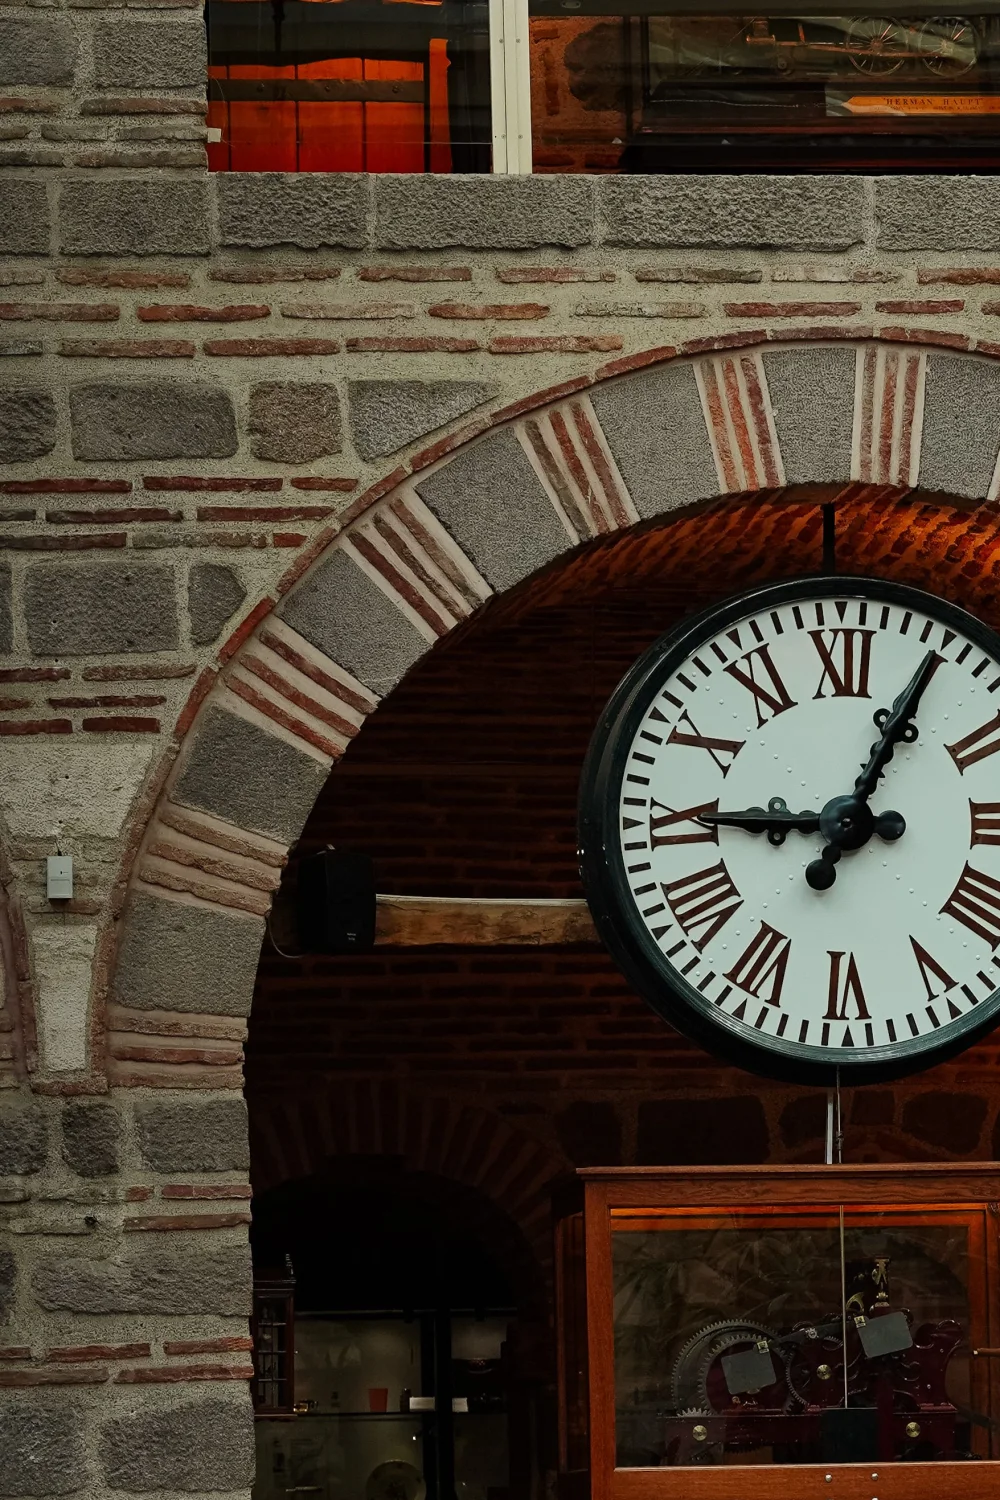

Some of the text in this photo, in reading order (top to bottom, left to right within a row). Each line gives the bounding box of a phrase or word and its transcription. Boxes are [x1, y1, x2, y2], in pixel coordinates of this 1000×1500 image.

[723, 643, 798, 729] XI
[807, 628, 877, 700] XII
[667, 709, 746, 778] X
[649, 796, 720, 852] IX
[660, 858, 744, 954] VIII
[722, 920, 791, 1008] VII
[822, 951, 872, 1020] VI
[909, 935, 960, 1001] V
